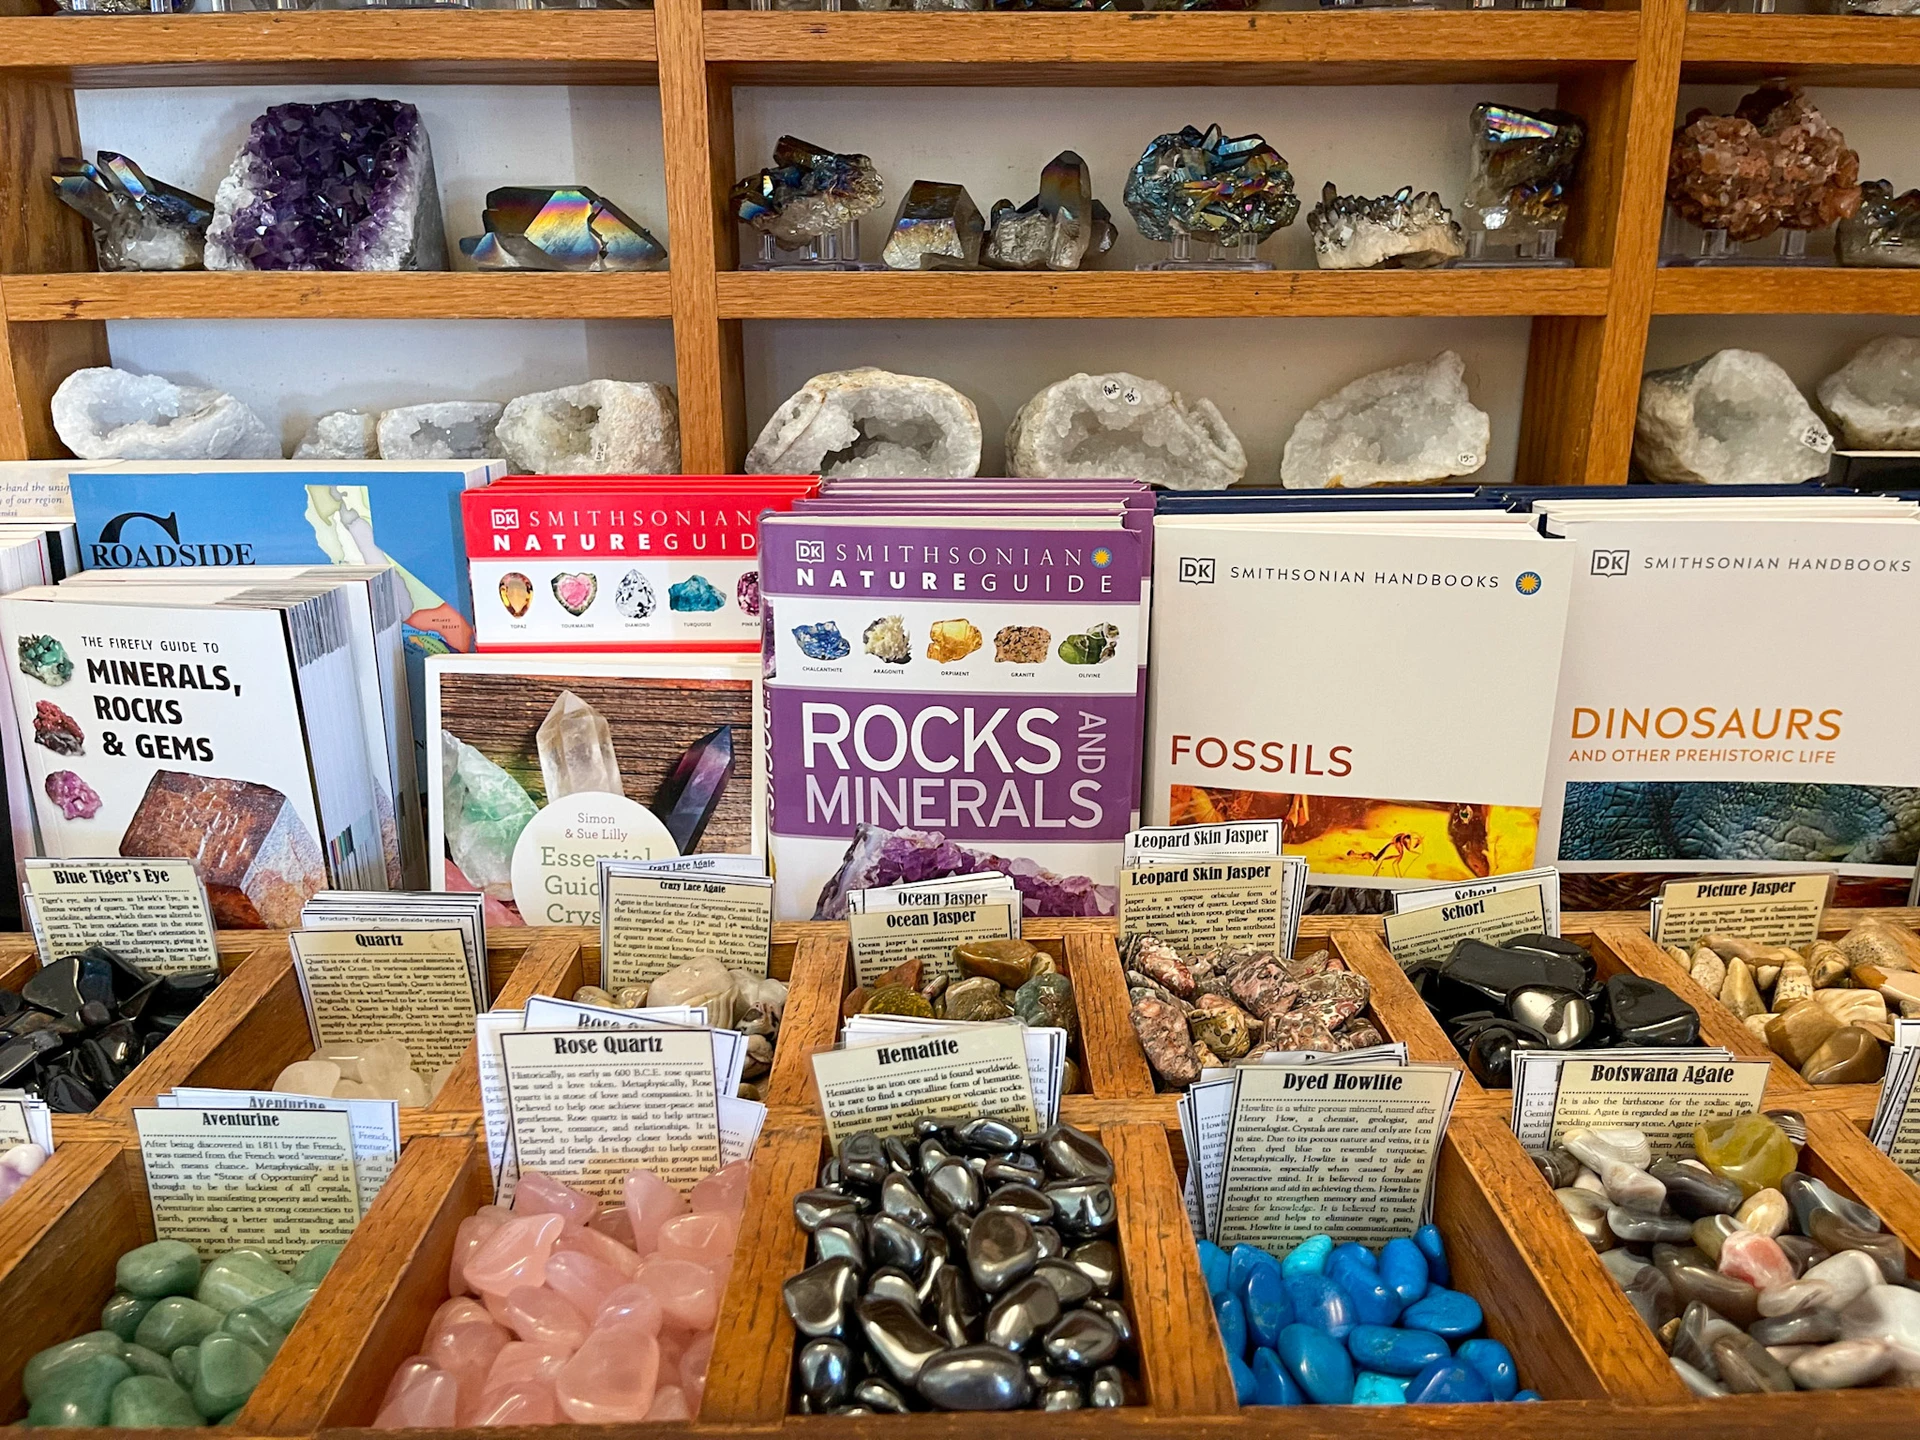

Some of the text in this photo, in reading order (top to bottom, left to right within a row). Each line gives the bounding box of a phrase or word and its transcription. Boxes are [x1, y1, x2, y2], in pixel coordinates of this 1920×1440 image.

[32, 482, 45, 492] the
[6, 495, 16, 507] of
[35, 495, 65, 508] region.
[530, 509, 752, 528] SMITHSONIAN
[91, 543, 256, 568] ROADSIDE
[836, 543, 1083, 567] SMITHSONIAN
[1643, 556, 1780, 570] SMITHSONIAN
[1787, 558, 1912, 573] HANDBOOKS
[1230, 565, 1366, 584] SMITHSONIAN
[1374, 571, 1500, 589] HANDBOOKS
[81, 636, 220, 654] THE FIREFLY GUIDE TO
[86, 658, 243, 697] MINERALS,
[802, 665, 843, 673] CHALCANTHITE
[93, 695, 184, 726] ROCKS
[1571, 707, 1844, 742] DINOSAURS
[102, 732, 215, 763] & GEMS
[802, 702, 1062, 775] ROCKS
[1077, 710, 1107, 774] AND
[1170, 734, 1353, 778] FOSSILS
[1568, 748, 1837, 764] AND OTHER PREHISTORIC LIFE
[805, 773, 1103, 829] MINERALS
[577, 812, 615, 824] Simon
[565, 828, 628, 843] & Sue Lilly
[1134, 827, 1269, 850] Leopard Skin Jasper
[53, 869, 88, 885] Blue
[144, 868, 170, 884] Eye
[1132, 865, 1271, 886] Leopard Skin Jasper
[660, 881, 726, 894] Crazy Lace Agate
[1696, 881, 1796, 899] Picture Jasper
[898, 891, 988, 907] Ocean Jasper
[886, 909, 976, 928] Ocean Jasper
[1442, 900, 1485, 922] Schorl
[355, 933, 404, 947] Quartz
[554, 1035, 664, 1055] Rose Quartz
[877, 1037, 960, 1066] Hematite
[512, 1070, 564, 1080] Historically,
[579, 1069, 599, 1079] early
[614, 1069, 631, 1077] 600
[685, 1069, 712, 1078] quartz
[826, 1086, 866, 1098] Hematite
[889, 1079, 906, 1088] iron
[907, 1077, 921, 1085] ore
[924, 1073, 939, 1082] and
[949, 1067, 974, 1079] found
[975, 1062, 1021, 1074] worldwide.
[1282, 1072, 1403, 1091] Dyed Howlite
[1591, 1064, 1735, 1084] Botswana Agate
[828, 1100, 835, 1108] It
[848, 1097, 865, 1105] rare
[867, 1094, 876, 1102] to
[878, 1091, 895, 1101] find
[905, 1084, 947, 1097] crystalline
[950, 1081, 970, 1089] form
[972, 1077, 981, 1086] of
[983, 1073, 1023, 1085] hematite.
[1240, 1103, 1274, 1112] Howlite
[1276, 1104, 1283, 1112] is
[1293, 1103, 1316, 1113] white
[1318, 1106, 1347, 1114] porous
[1349, 1105, 1383, 1114] mineral,
[1385, 1106, 1414, 1114] named
[1416, 1106, 1436, 1114] after
[1560, 1096, 1753, 1108] It is also the birthstone for the zodiac sign,
[202, 1112, 280, 1127] Aventurine
[145, 1140, 346, 1151] After being discovered in 1811 by the French,
